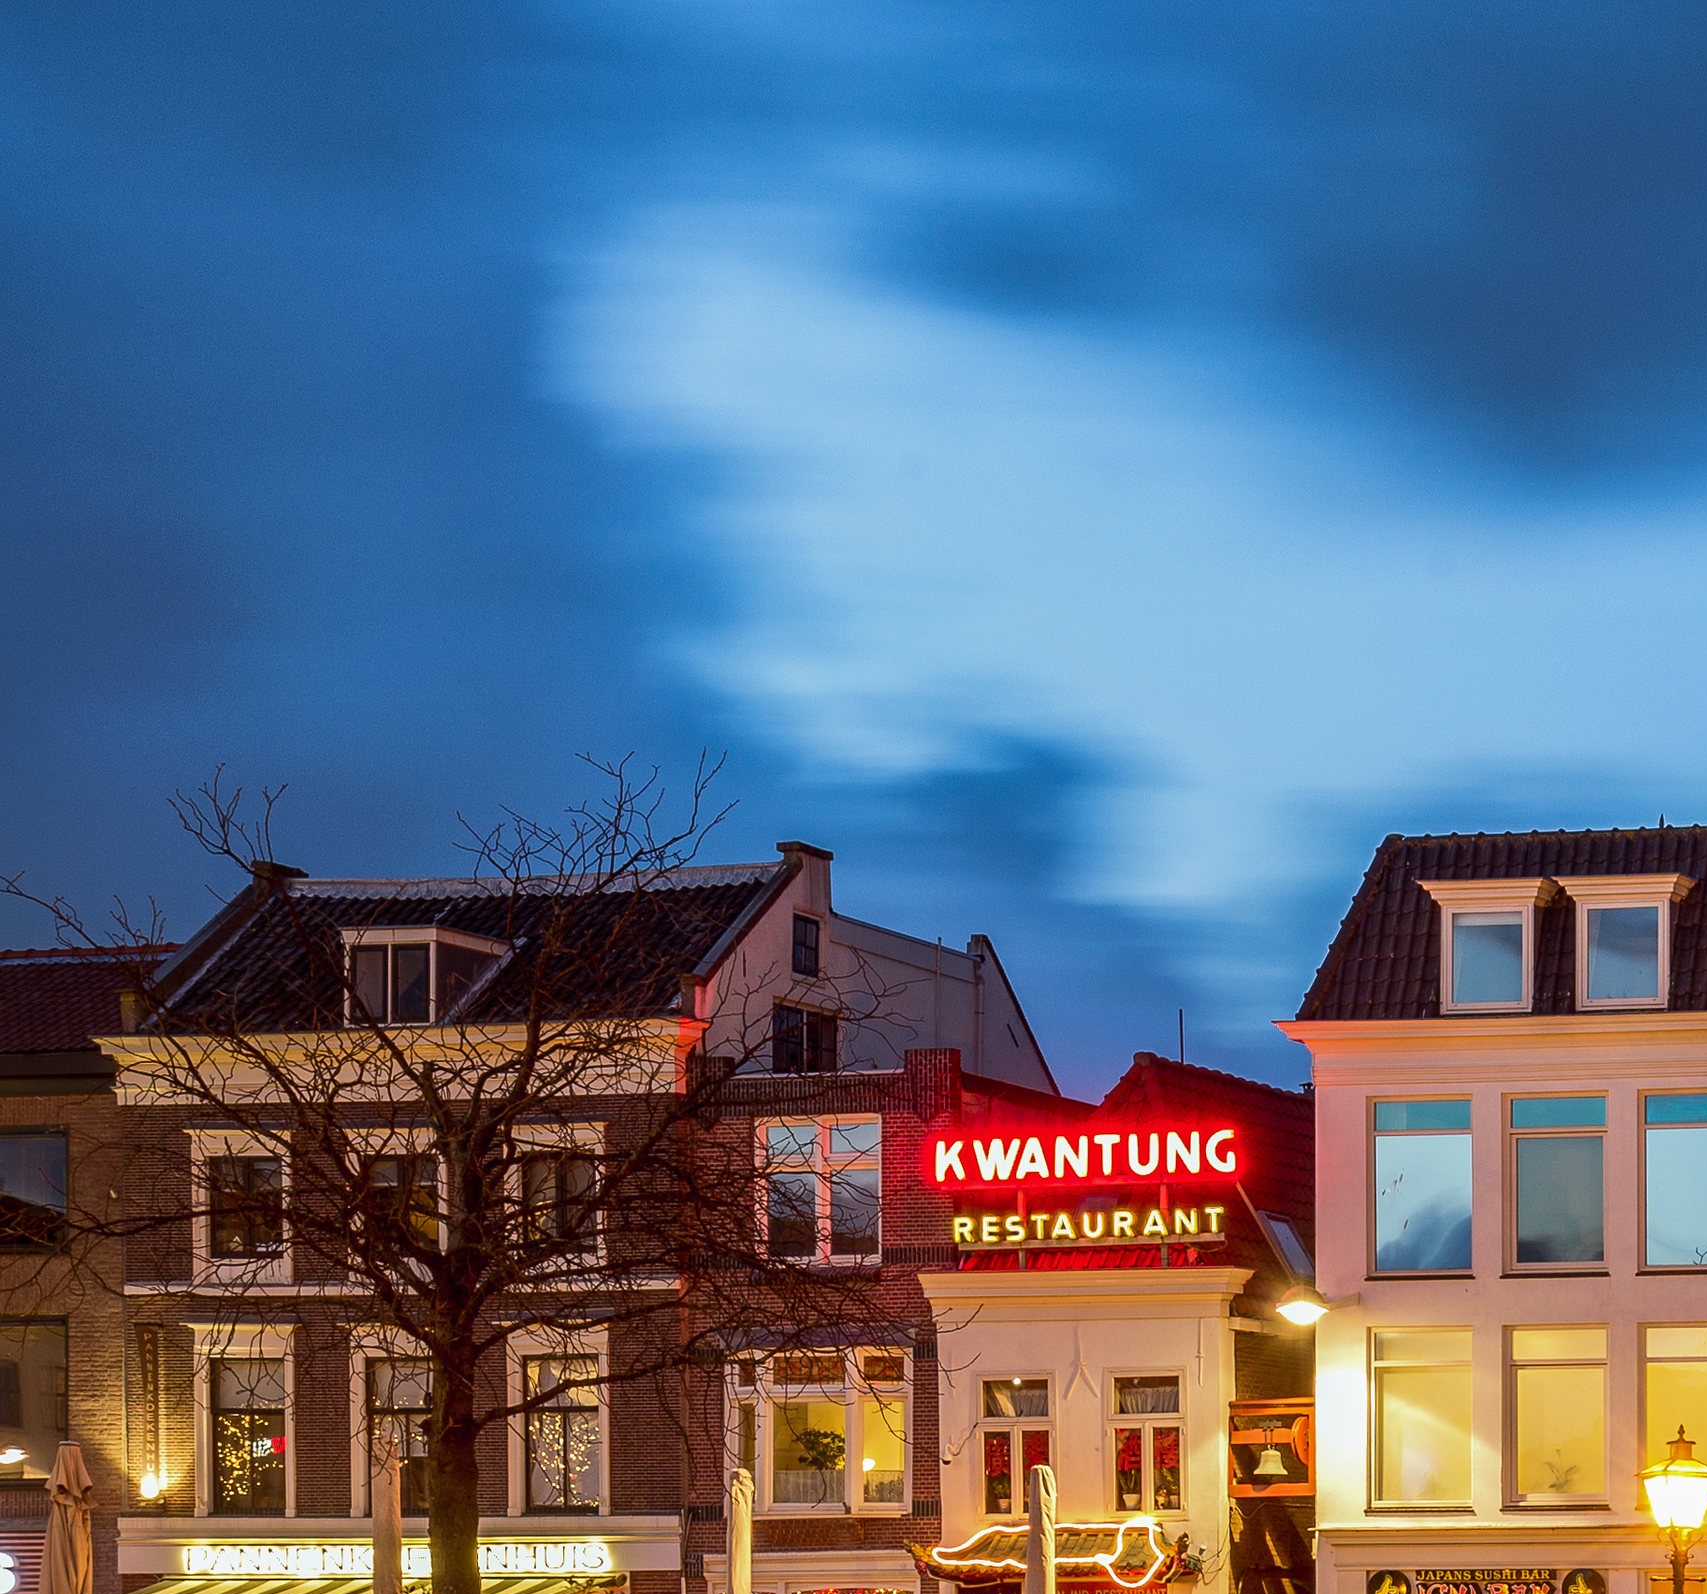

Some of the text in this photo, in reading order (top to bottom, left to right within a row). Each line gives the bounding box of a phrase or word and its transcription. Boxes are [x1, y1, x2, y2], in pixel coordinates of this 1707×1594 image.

[936, 1129, 1236, 1182] KWANTUNG
[953, 1207, 1224, 1243] RESTAURANT
[1417, 1569, 1550, 1581] JAPANS SUSHI BAR
